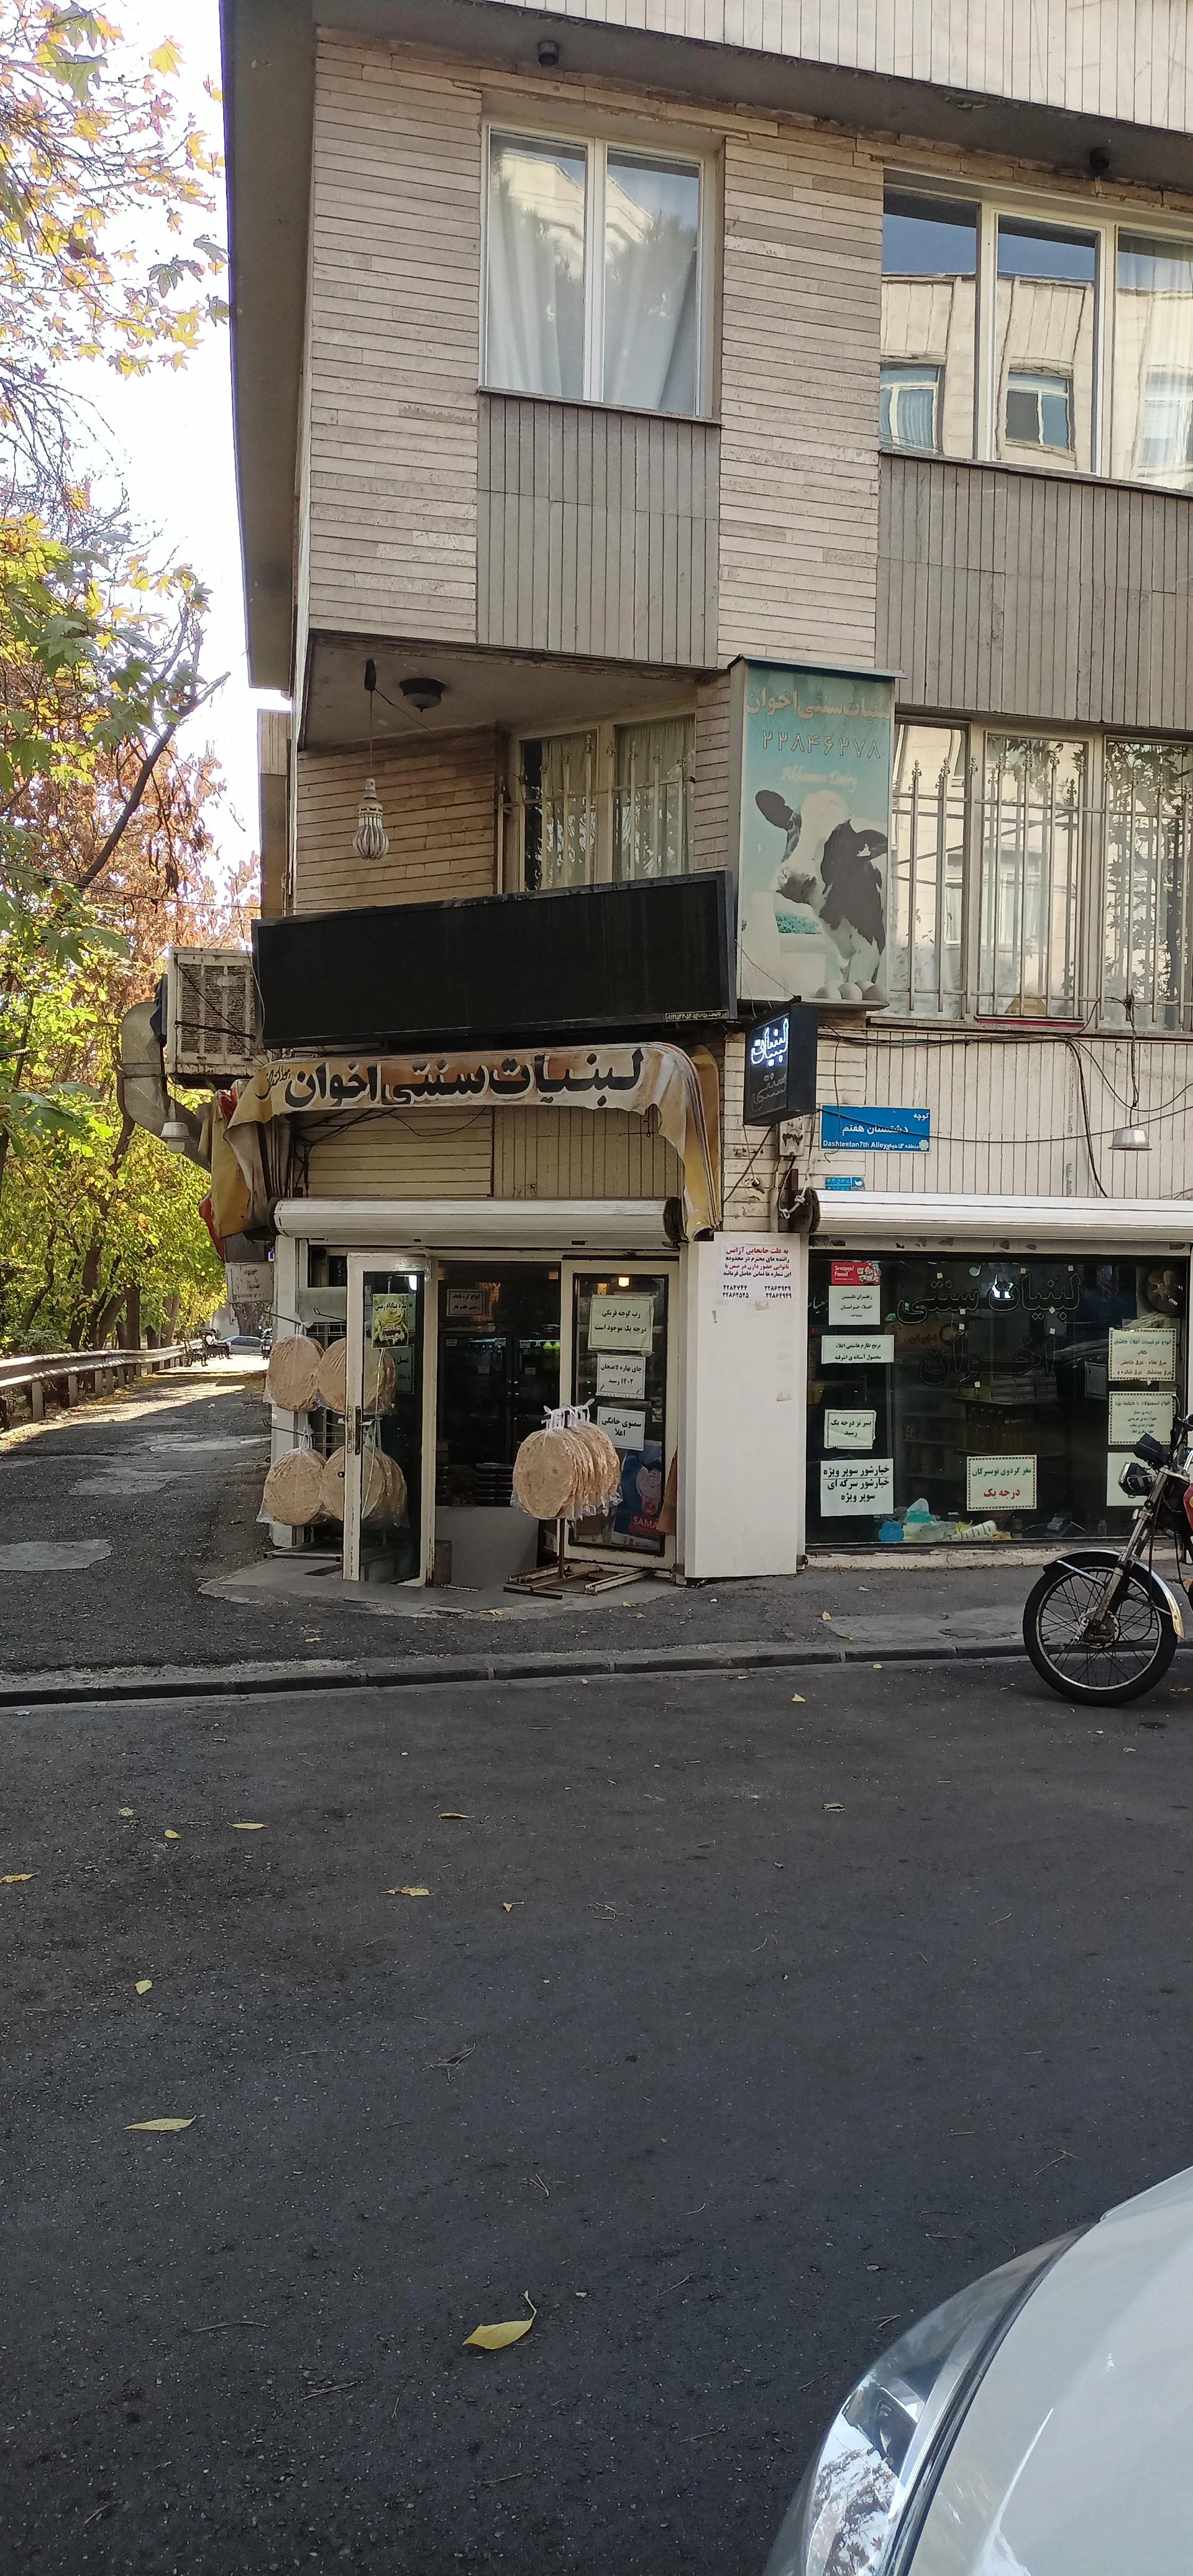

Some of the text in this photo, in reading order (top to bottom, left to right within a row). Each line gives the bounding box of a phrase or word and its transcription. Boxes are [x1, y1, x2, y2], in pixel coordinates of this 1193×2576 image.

[747, 686, 797, 716] اخوان
[797, 695, 843, 720] سنتی
[763, 731, 880, 759] ۲۲۸۴۶۲۷۸
[751, 1018, 790, 1066] لبنیات
[382, 1058, 486, 1106] سنتی
[490, 1048, 644, 1107] لبنیات
[285, 1062, 378, 1108] اخوان
[751, 1073, 787, 1112] سنتی
[913, 1112, 930, 1121] کوچه
[842, 1124, 864, 1136] هفتم
[726, 1246, 744, 1255] آژانس
[746, 1247, 769, 1255] جابجایی
[897, 1273, 1081, 1324] لبنیات سنتی
[601, 1309, 617, 1318] فرنگی
[618, 1310, 631, 1318] گوجه
[624, 1325, 632, 1333] یک
[920, 1335, 1056, 1387] اخوان
[632, 1365, 642, 1373] چای
[601, 1417, 642, 1428] سمنوی خانگی
[615, 1428, 626, 1436] اعلا
[823, 1465, 890, 1478] خیارشور سوپر ویژه
[1000, 1467, 1020, 1476] گردوی
[1022, 1467, 1032, 1475] مغز
[827, 1477, 889, 1490] خیارشور سرکه ای
[841, 1492, 875, 1503] سوپر ویژه
[984, 1488, 1020, 1500] درجه یک
